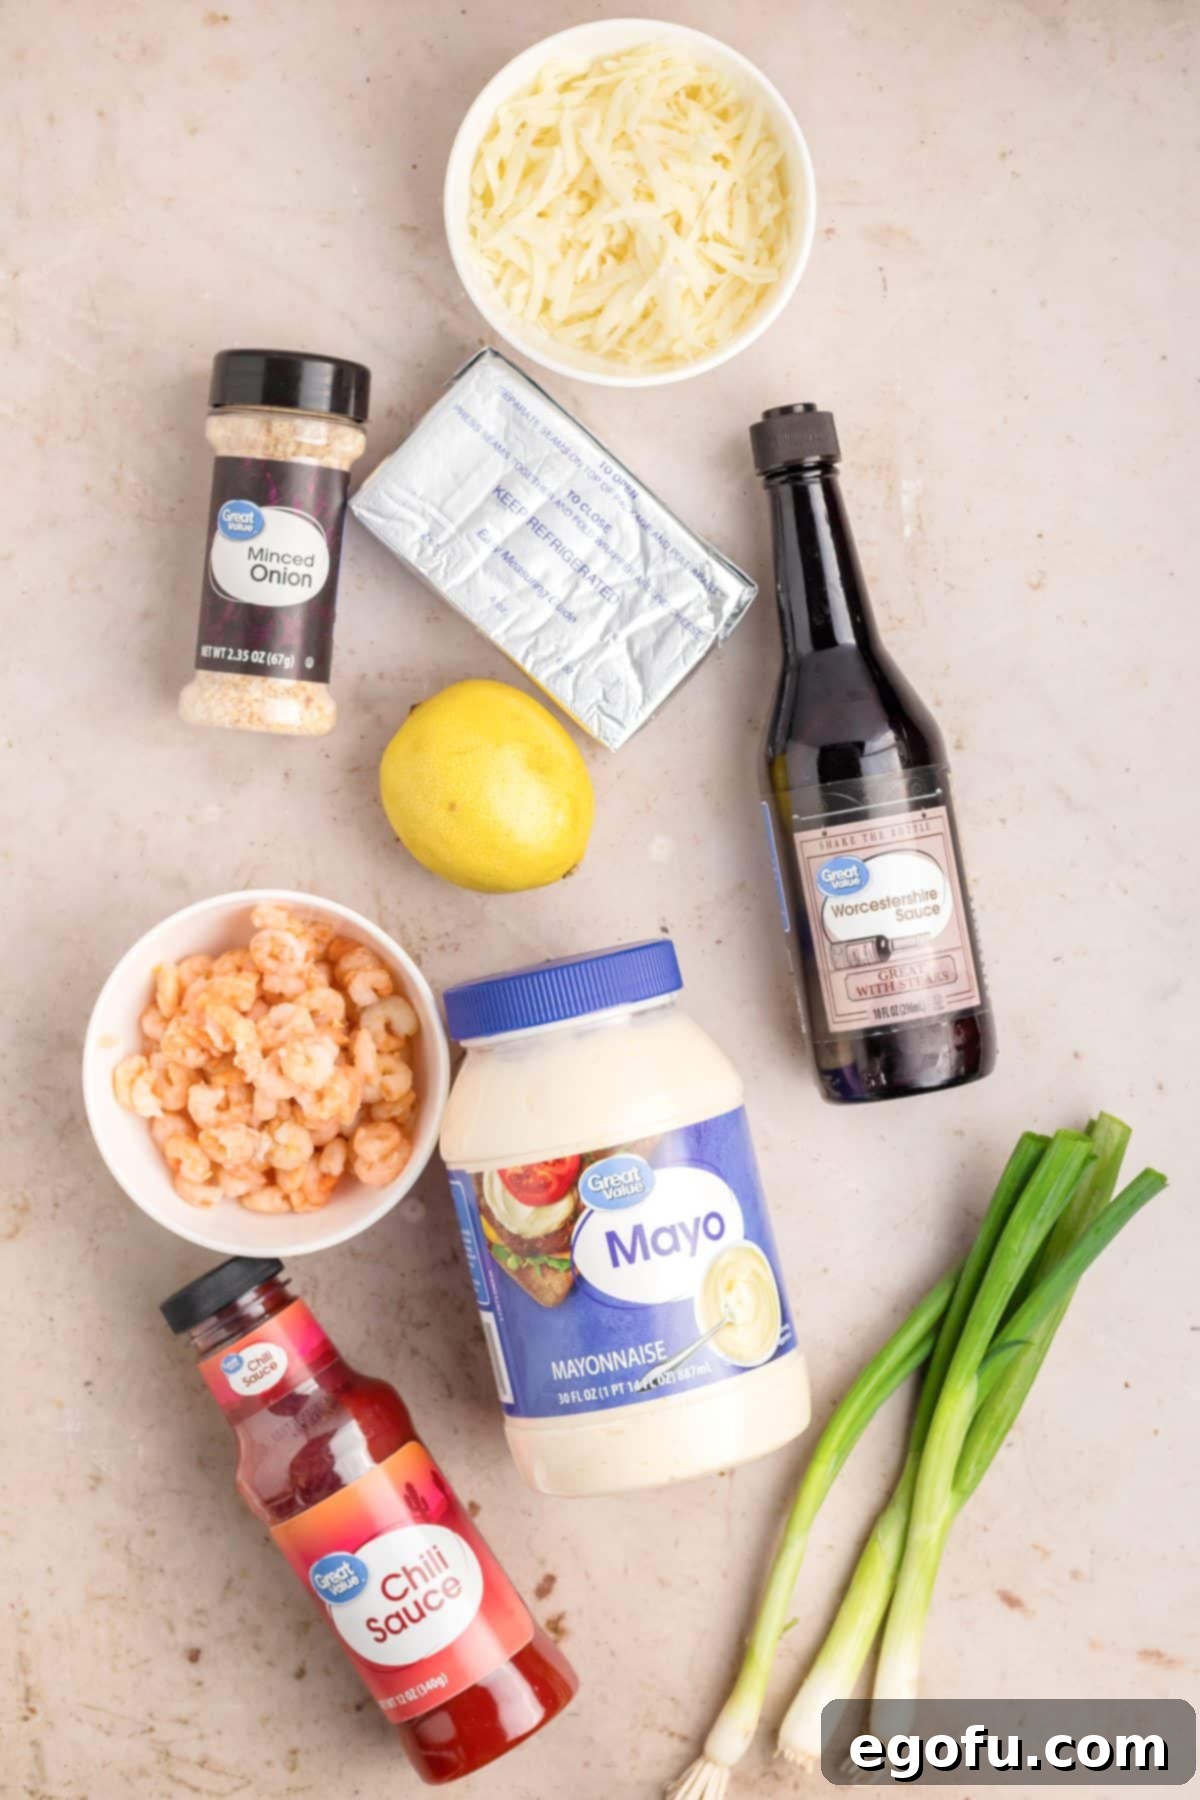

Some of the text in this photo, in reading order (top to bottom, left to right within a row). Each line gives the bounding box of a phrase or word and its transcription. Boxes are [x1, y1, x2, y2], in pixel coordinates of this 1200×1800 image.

[452, 404, 481, 432] PRESS
[481, 430, 511, 459] SEAMS
[553, 498, 573, 517] AND
[539, 425, 570, 455] SEAMS
[582, 466, 601, 484] TOP
[650, 530, 671, 550] AND
[598, 461, 639, 500] TO OPEN
[223, 509, 254, 524] Great
[565, 489, 612, 533] TO CLOSE
[227, 521, 253, 532] Value
[248, 547, 314, 567] Minced
[492, 484, 621, 606] KEEP REFRIGERATED
[475, 526, 502, 553] Eay
[498, 548, 551, 599] Measuring
[251, 564, 312, 588] Onion
[213, 646, 227, 659] WT
[227, 648, 249, 662] 2.35
[251, 651, 265, 663] OZ
[267, 653, 294, 669] (67g)
[819, 822, 931, 849] SHAKE THE BOTTLE
[821, 864, 859, 882] Great
[831, 876, 860, 889] Value
[831, 888, 938, 918] Worcestershire
[896, 904, 940, 922] Sauce
[878, 963, 926, 981] GREAT
[855, 981, 895, 998] WITH
[872, 1008, 882, 1020] 10
[588, 1166, 642, 1191] Great
[602, 1181, 645, 1199] Value
[605, 1211, 725, 1268] Mayo
[248, 1350, 272, 1371] Chili
[551, 1340, 668, 1381] MAYONNAISE
[242, 1362, 278, 1387] Sauce
[558, 1392, 570, 1405] 30
[571, 1389, 582, 1403] FL
[584, 1388, 598, 1401] OZ
[598, 1386, 609, 1402] (1
[611, 1383, 626, 1398] PT
[314, 1562, 356, 1592] Great
[381, 1545, 449, 1601] Chili
[329, 1575, 362, 1596] Value
[366, 1576, 462, 1643] Sauce
